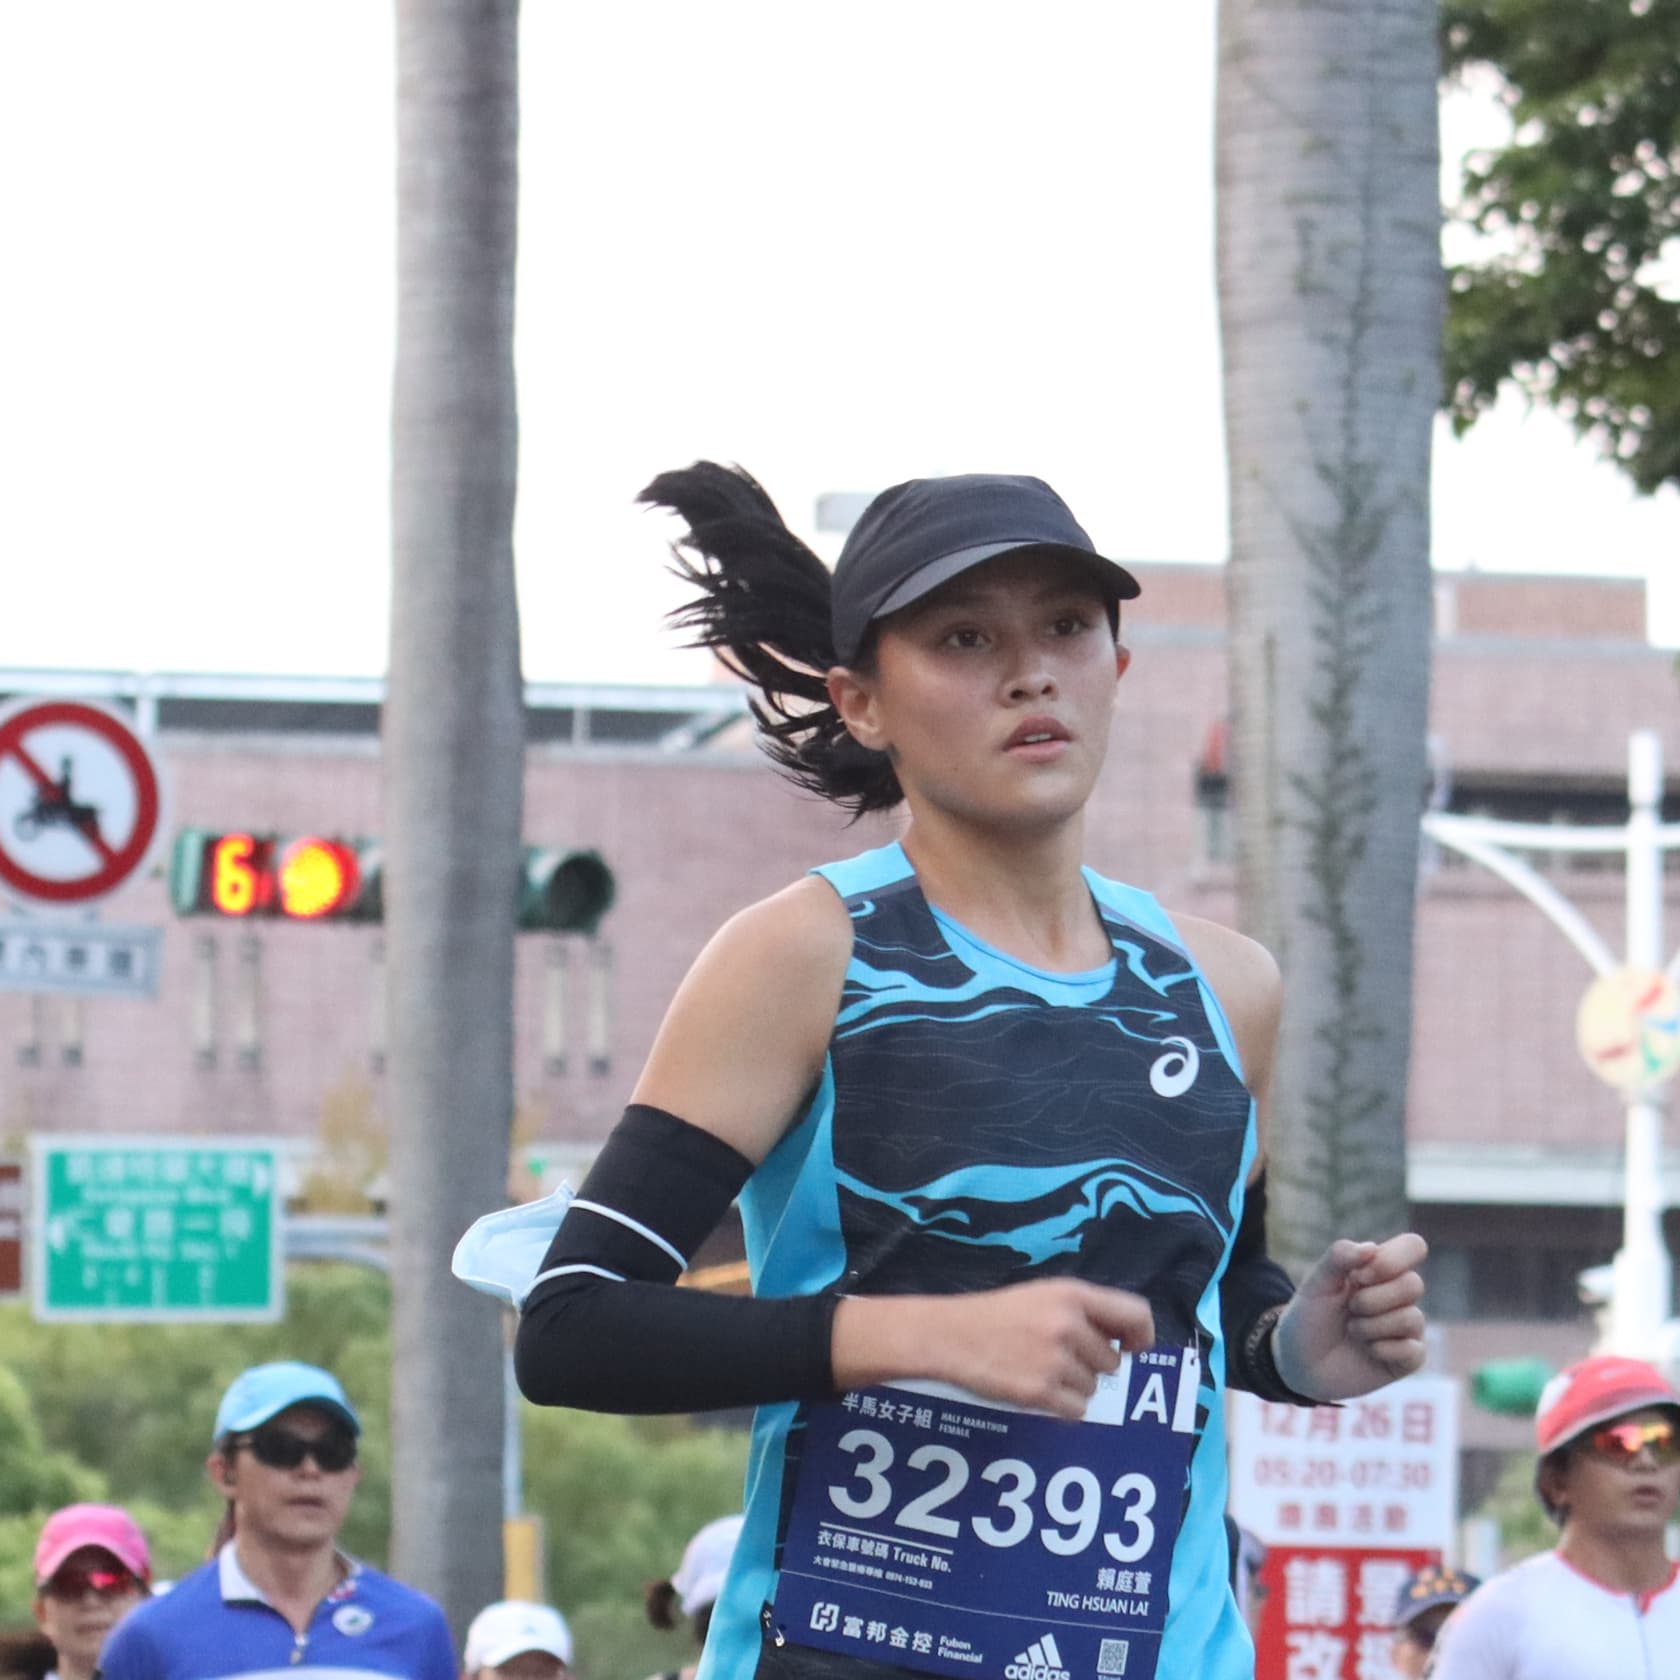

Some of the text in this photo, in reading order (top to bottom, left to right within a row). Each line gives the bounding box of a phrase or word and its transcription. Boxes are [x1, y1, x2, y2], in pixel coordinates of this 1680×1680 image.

[841, 1391, 933, 1430] 半馬女子組
[1130, 1373, 1168, 1424] A
[828, 1429, 1156, 1563] 32393
[892, 1547, 927, 1567] Truck
[930, 1554, 952, 1573] No.
[1096, 1567, 1152, 1595] 賴庭萱
[1046, 1591, 1149, 1616] TING HSUAN LAI
[842, 1616, 933, 1654] 富邦金控
[937, 1646, 984, 1664] Financial
